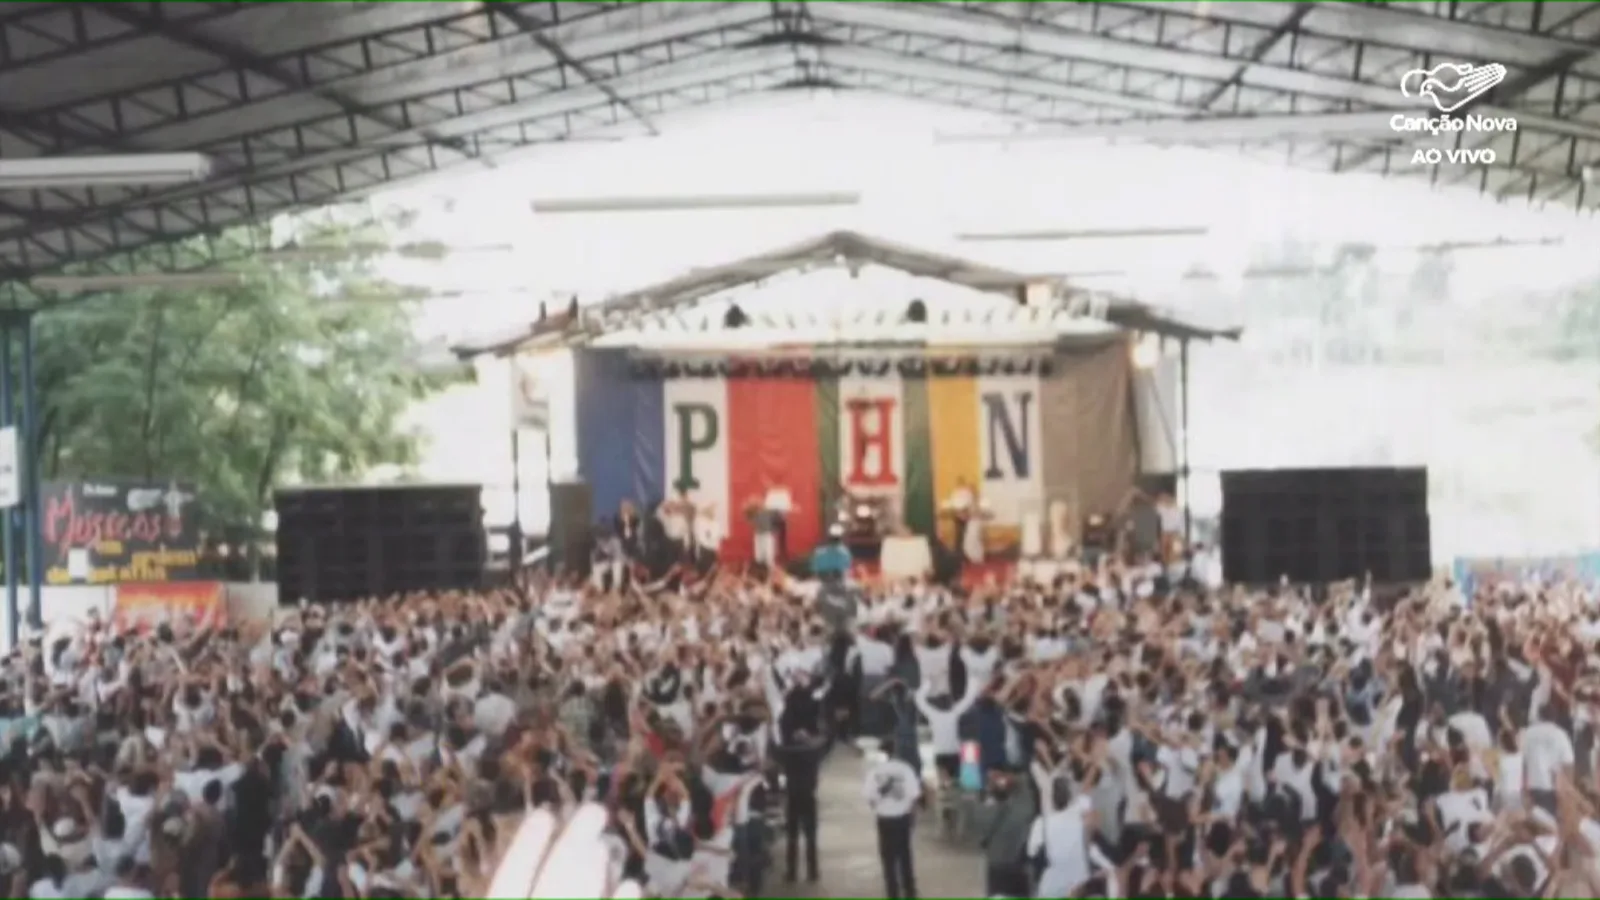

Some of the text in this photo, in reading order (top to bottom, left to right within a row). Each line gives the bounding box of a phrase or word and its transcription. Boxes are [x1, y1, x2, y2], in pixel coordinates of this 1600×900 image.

[673, 392, 1032, 491] P H N
